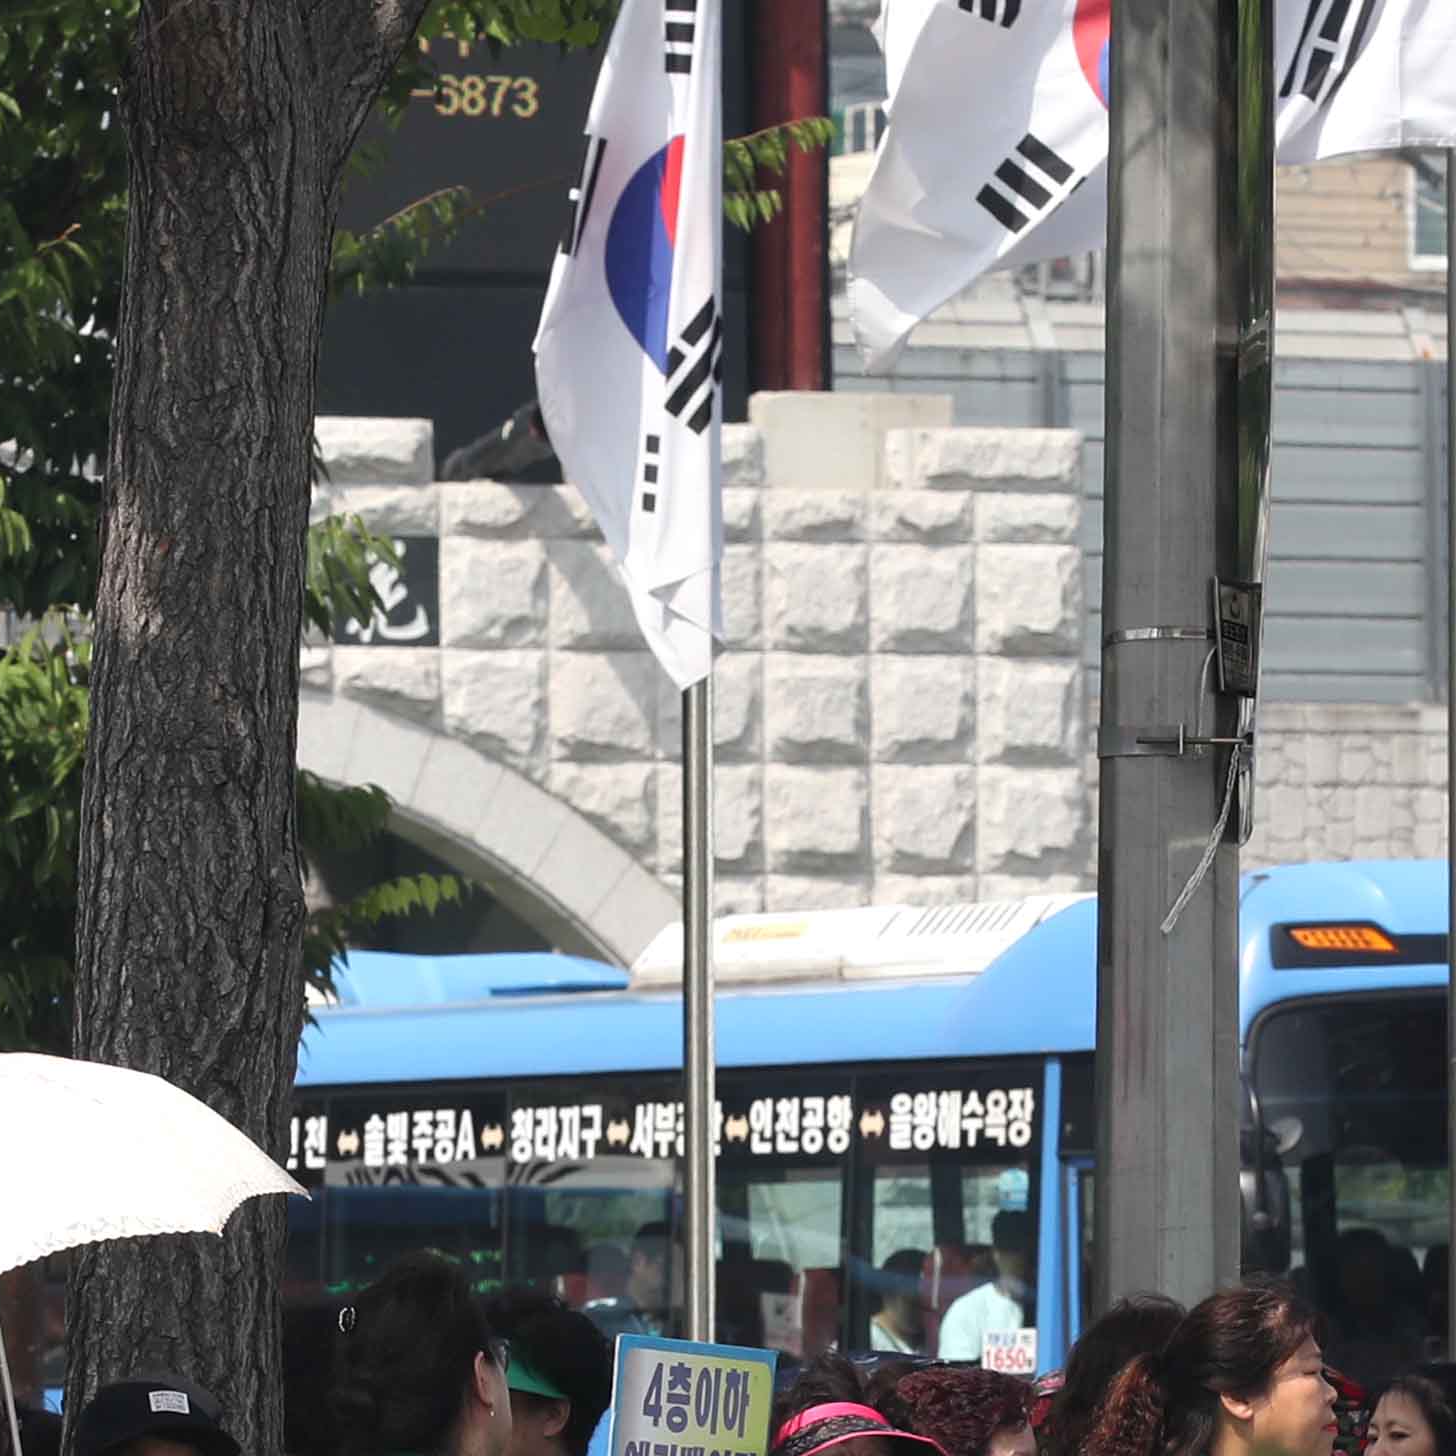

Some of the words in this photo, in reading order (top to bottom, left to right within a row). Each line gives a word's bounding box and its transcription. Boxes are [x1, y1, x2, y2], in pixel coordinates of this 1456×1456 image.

[364, 1110, 476, 1167] 솔빛주공A
[510, 1104, 603, 1163] 청라지구
[749, 1096, 853, 1154] 인천공항
[889, 1087, 1035, 1151] 을왕해수욕장
[642, 1360, 752, 1440] 4층이하
